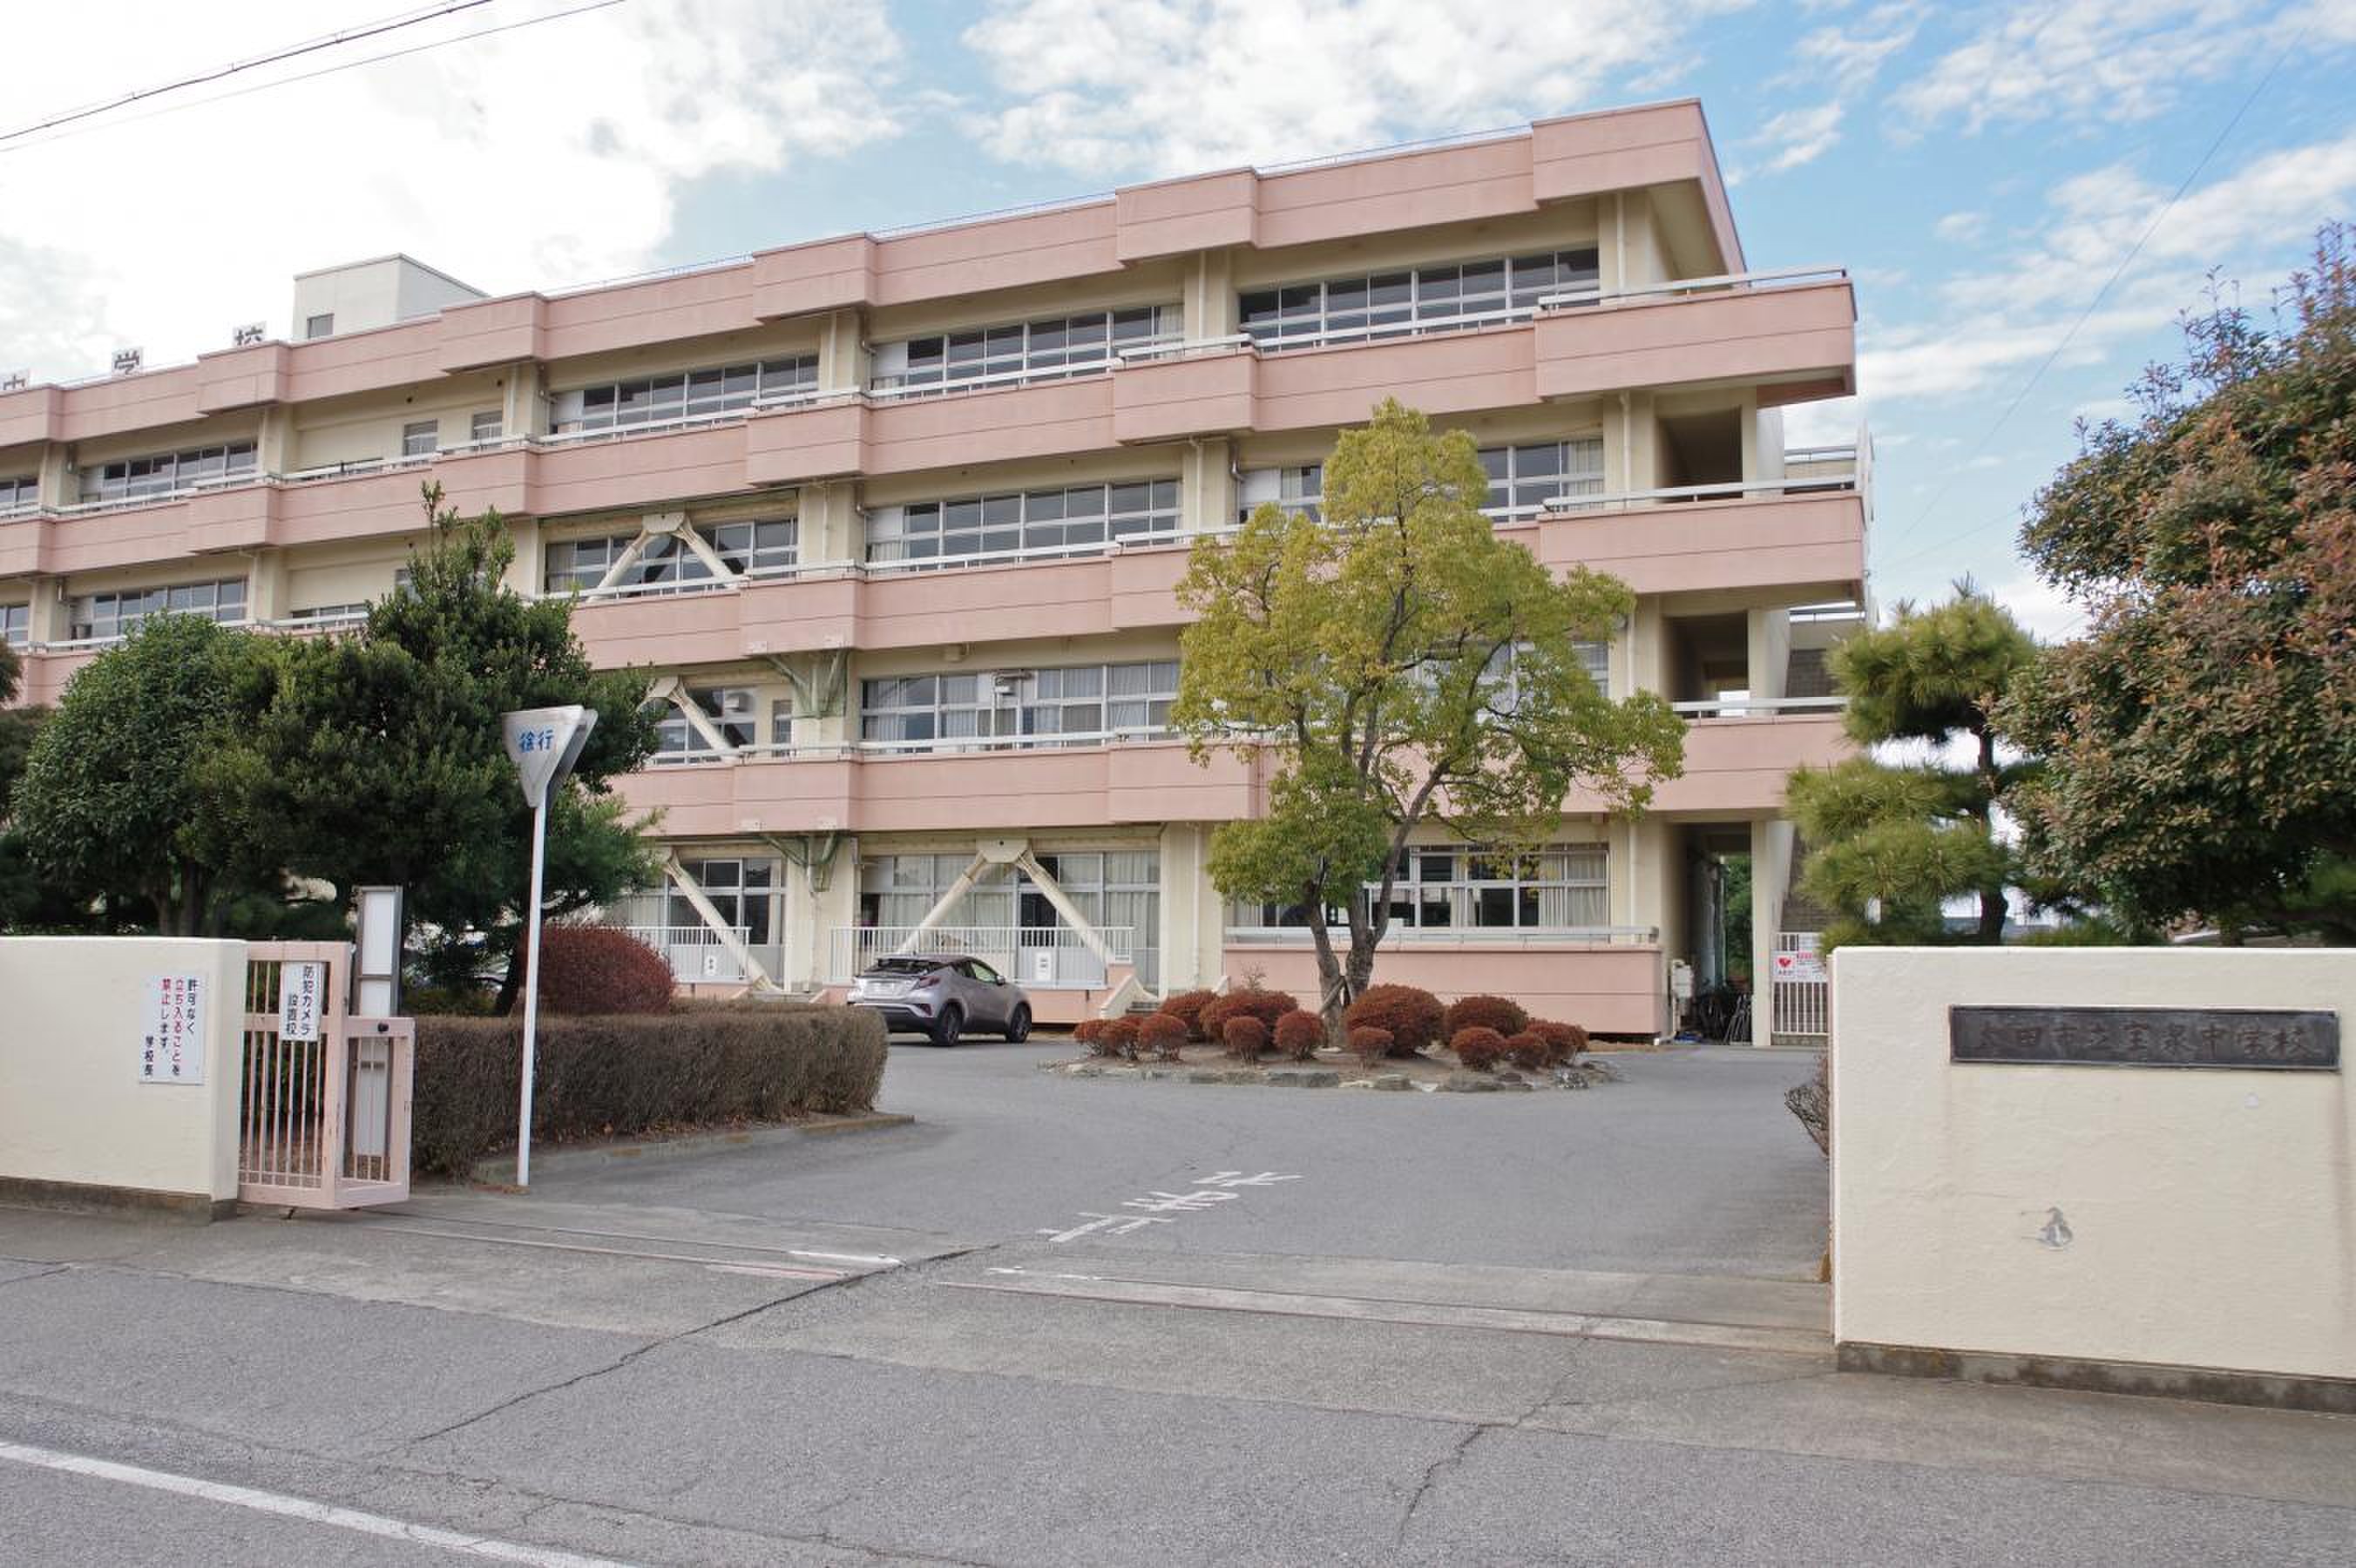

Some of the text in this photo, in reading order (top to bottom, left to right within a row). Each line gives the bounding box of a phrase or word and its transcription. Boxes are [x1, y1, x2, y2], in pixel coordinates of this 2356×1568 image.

[518, 729, 554, 753] 徐行
[172, 978, 185, 1076] 立ち入ることを
[186, 978, 199, 1034] 許可なく
[301, 965, 315, 1037] 防犯カメラ
